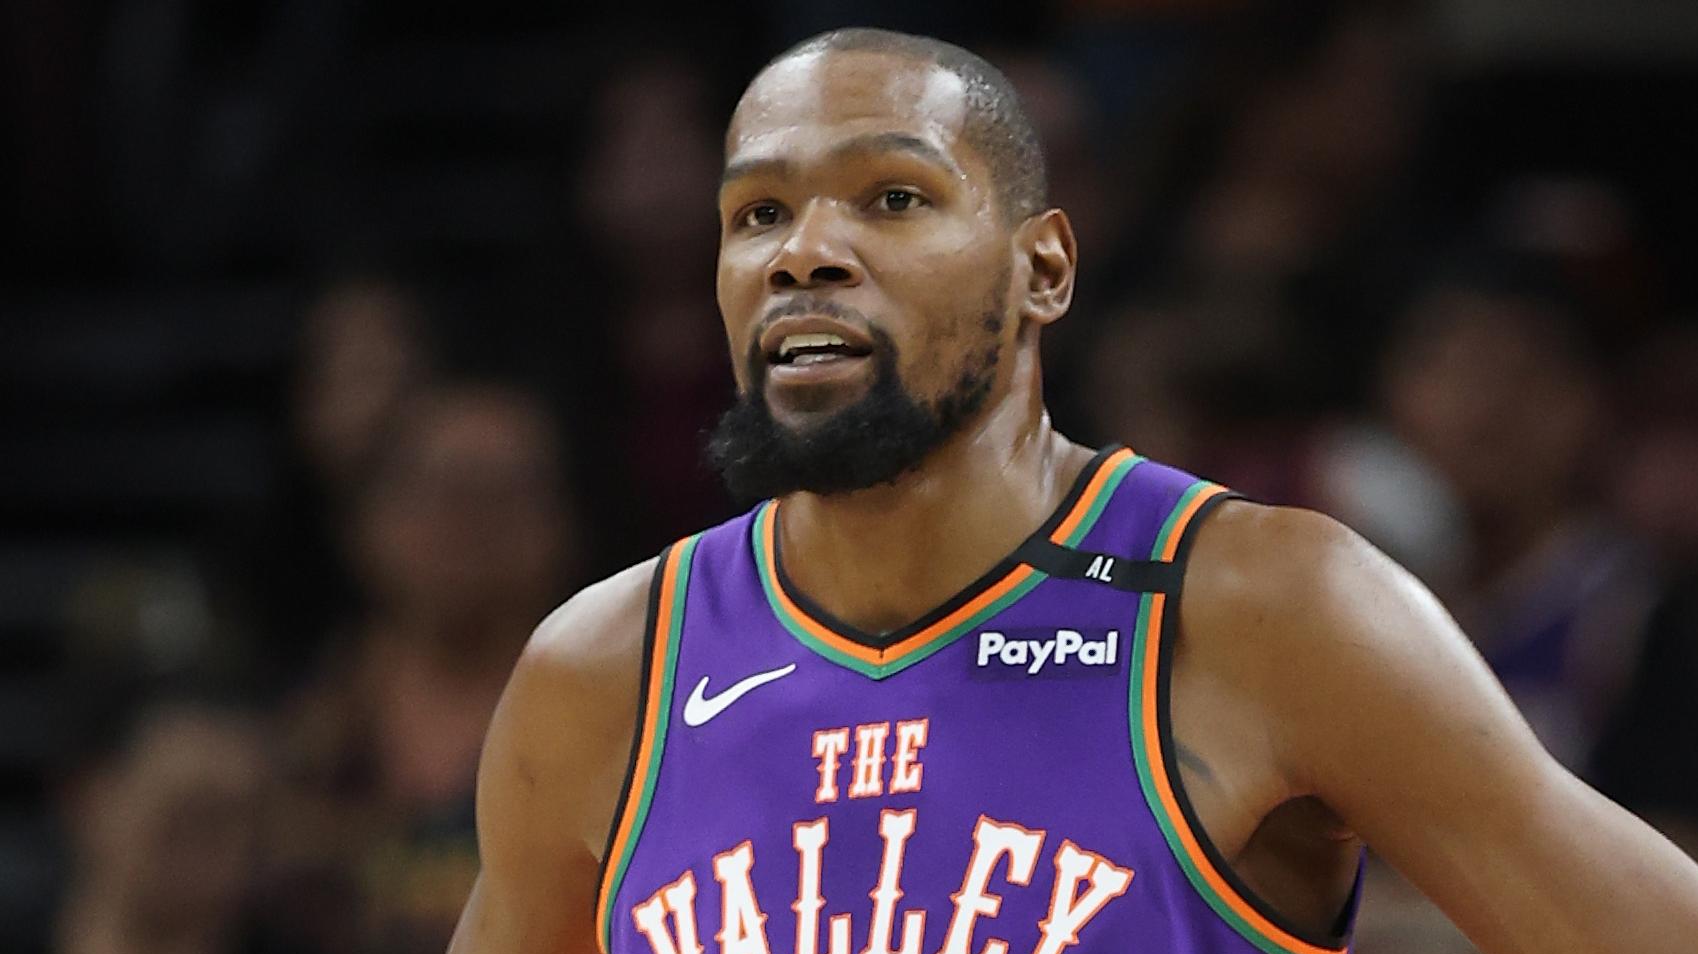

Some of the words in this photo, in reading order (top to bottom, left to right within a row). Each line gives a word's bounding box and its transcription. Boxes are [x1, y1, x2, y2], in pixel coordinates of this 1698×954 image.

[1085, 555, 1114, 582] AL
[977, 630, 1118, 674] PayPal
[812, 718, 930, 803] THE
